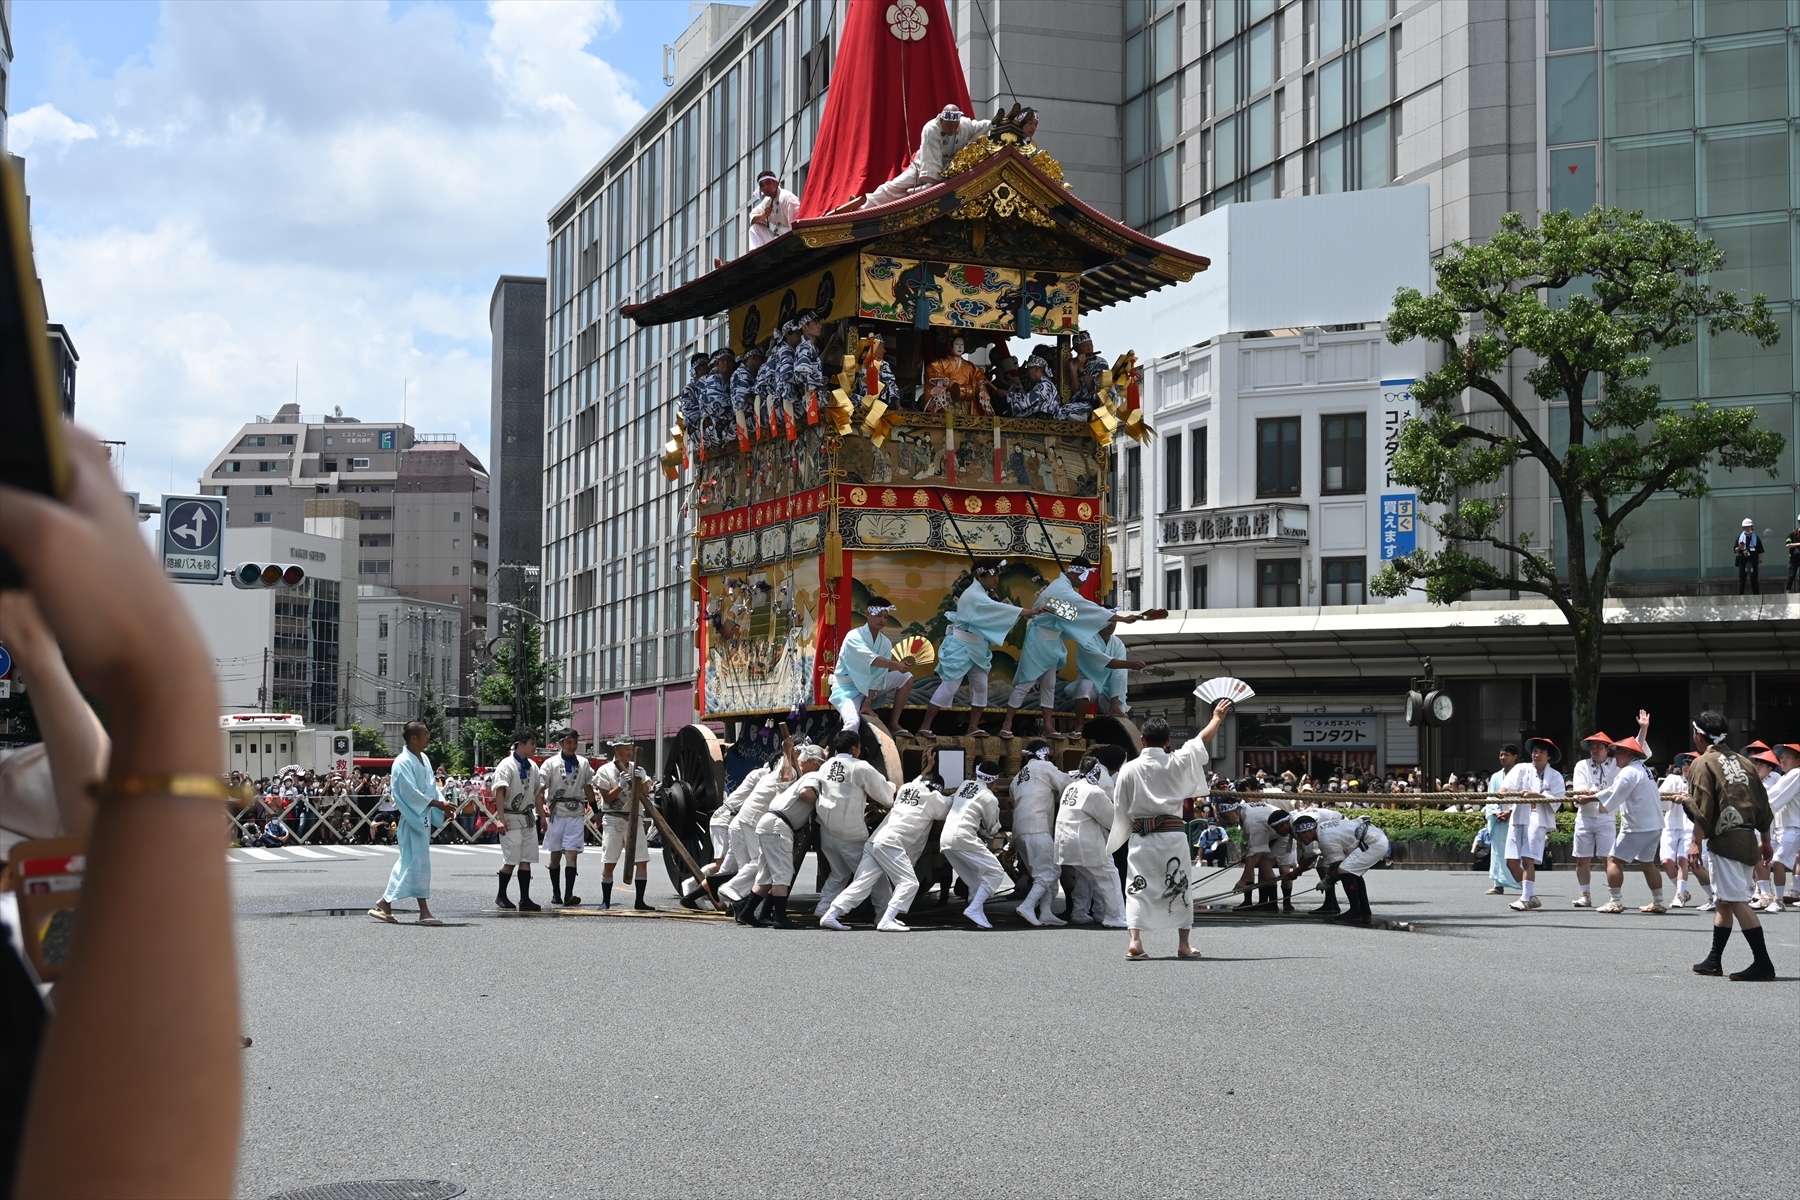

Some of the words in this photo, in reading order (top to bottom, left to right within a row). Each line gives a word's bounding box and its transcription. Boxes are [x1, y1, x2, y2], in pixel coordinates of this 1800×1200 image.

[1400, 502, 1411, 530] すぐ
[1163, 513, 1270, 543] 池善化粧品店
[1384, 501, 1397, 558] 買えます
[166, 557, 217, 570] 路線バスを除く
[1323, 719, 1367, 727] メガネスーパー
[1303, 729, 1367, 743] コンタクト
